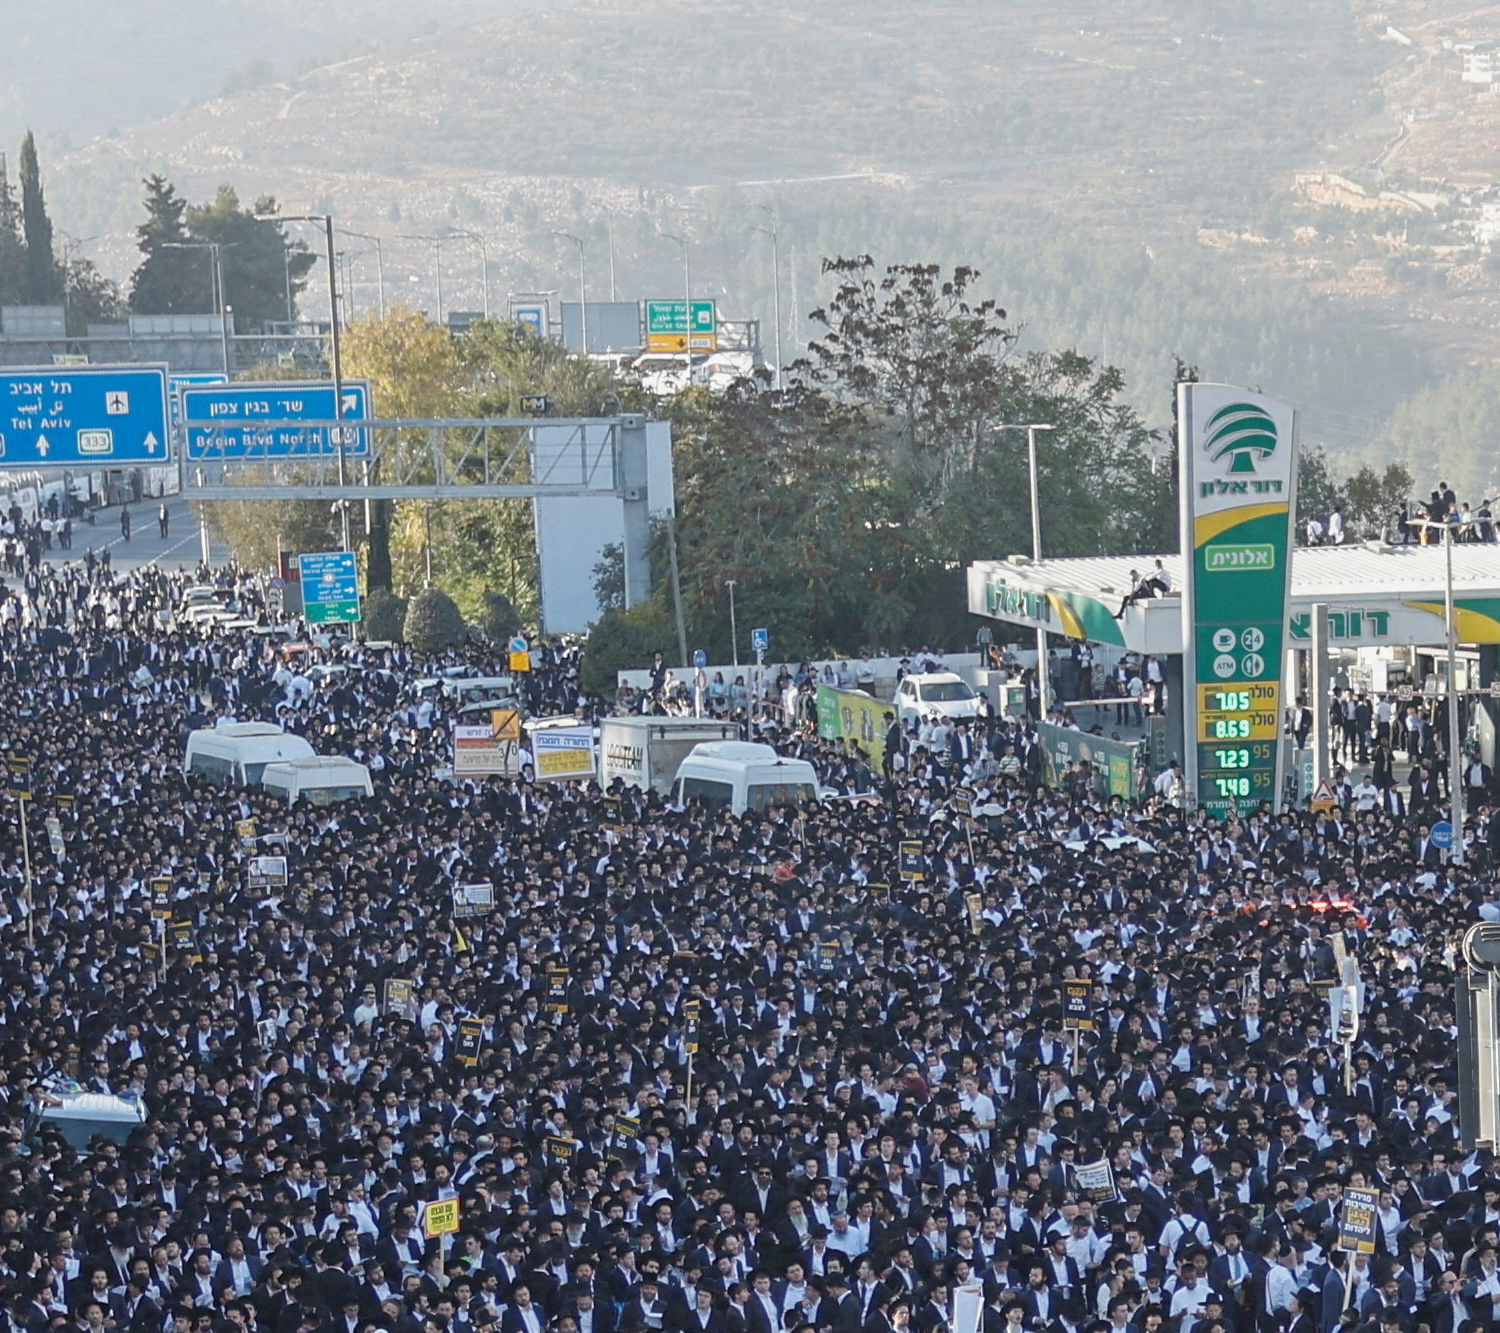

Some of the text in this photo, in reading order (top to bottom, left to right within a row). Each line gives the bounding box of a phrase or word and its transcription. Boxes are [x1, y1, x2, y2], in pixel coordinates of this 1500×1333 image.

[9, 380, 73, 395] תל אביב
[210, 402, 238, 417] צפון
[245, 401, 270, 416] בגין
[10, 416, 73, 430] Tel Aviv
[1200, 478, 1283, 498] דור אלון
[1212, 549, 1268, 566] אלונית
[1217, 661, 1234, 671] ATM
[1248, 686, 1274, 699] סולר
[1215, 692, 1250, 711] 7.05
[1249, 713, 1275, 726] סולר
[1215, 719, 1250, 739] 8.69
[1215, 749, 1249, 768] 7.23
[1254, 744, 1270, 759] 95
[1254, 772, 1270, 788] 95
